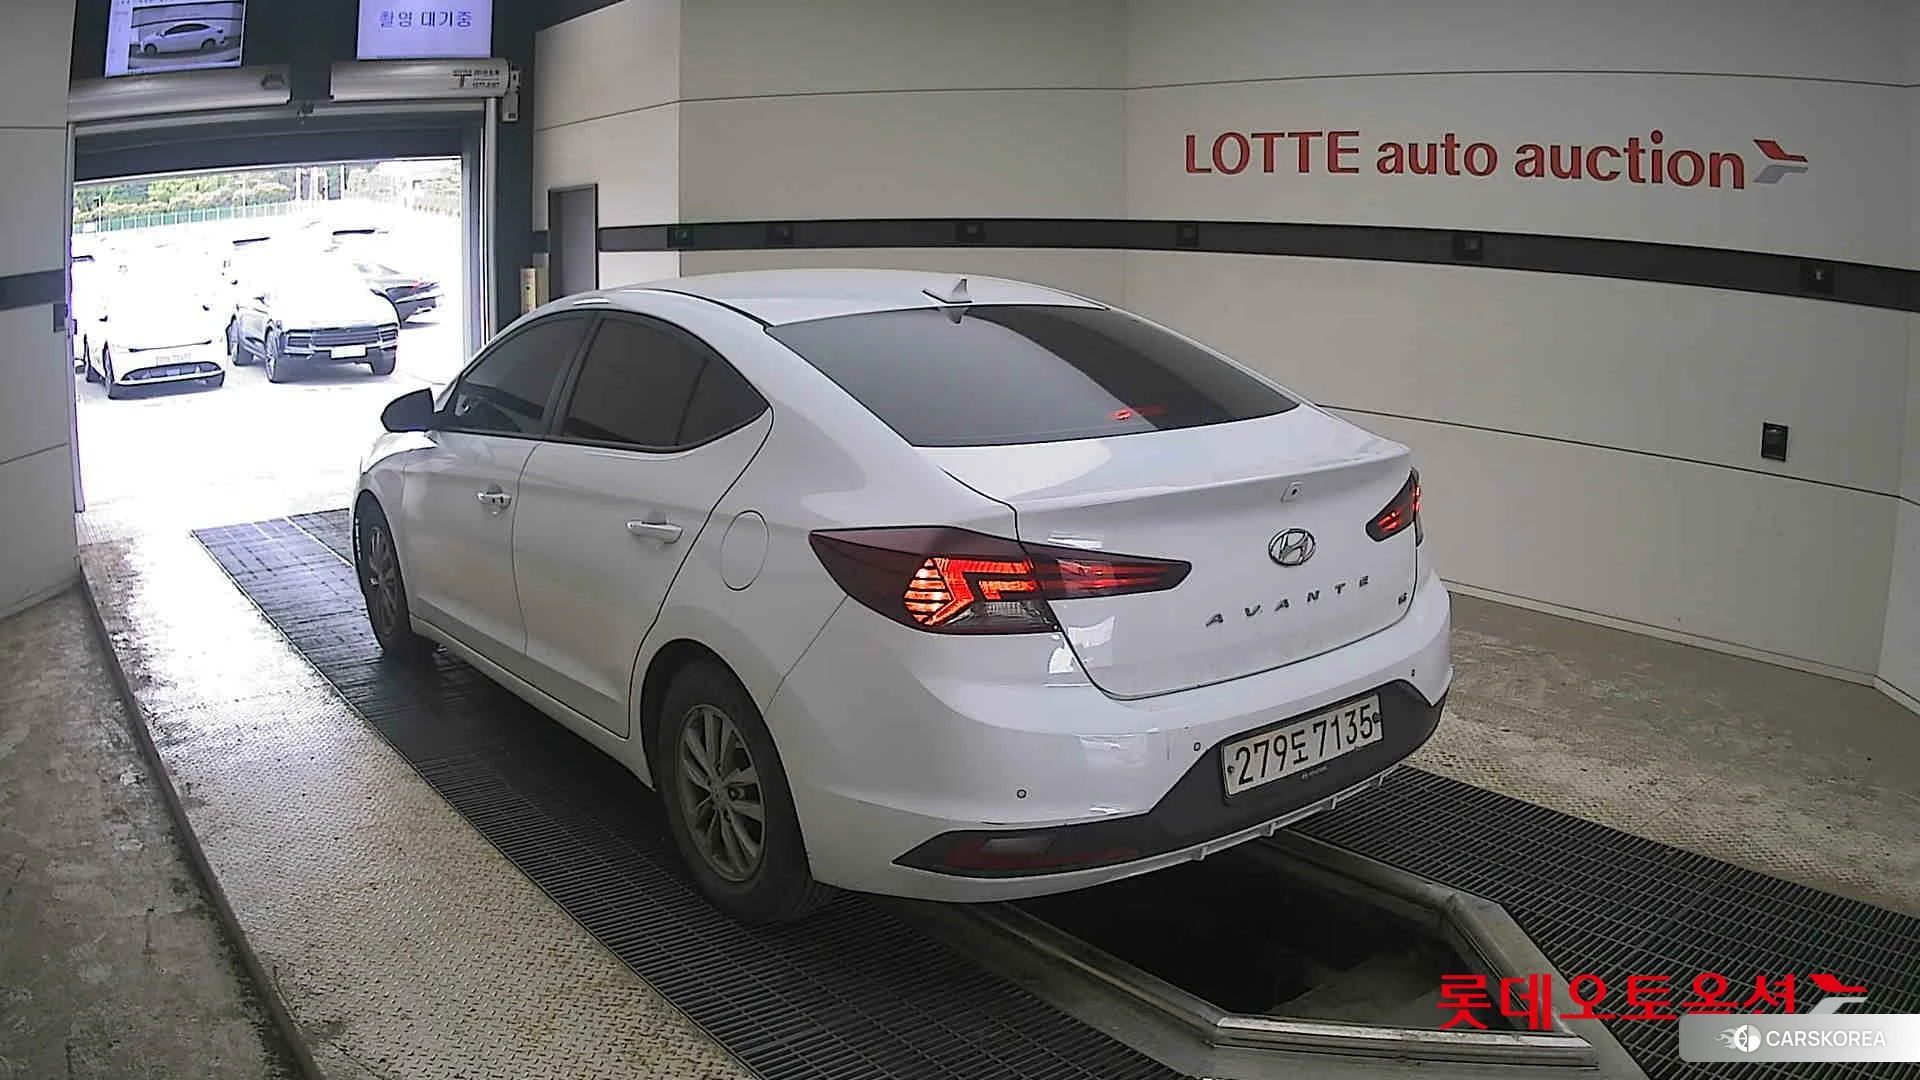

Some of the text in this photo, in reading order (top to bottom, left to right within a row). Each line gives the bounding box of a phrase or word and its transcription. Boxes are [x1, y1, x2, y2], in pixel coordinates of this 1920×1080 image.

[420, 10, 472, 28] 대기중
[1185, 129, 1745, 189] LOTTE auto auction
[1205, 575, 1369, 627] AVANTE
